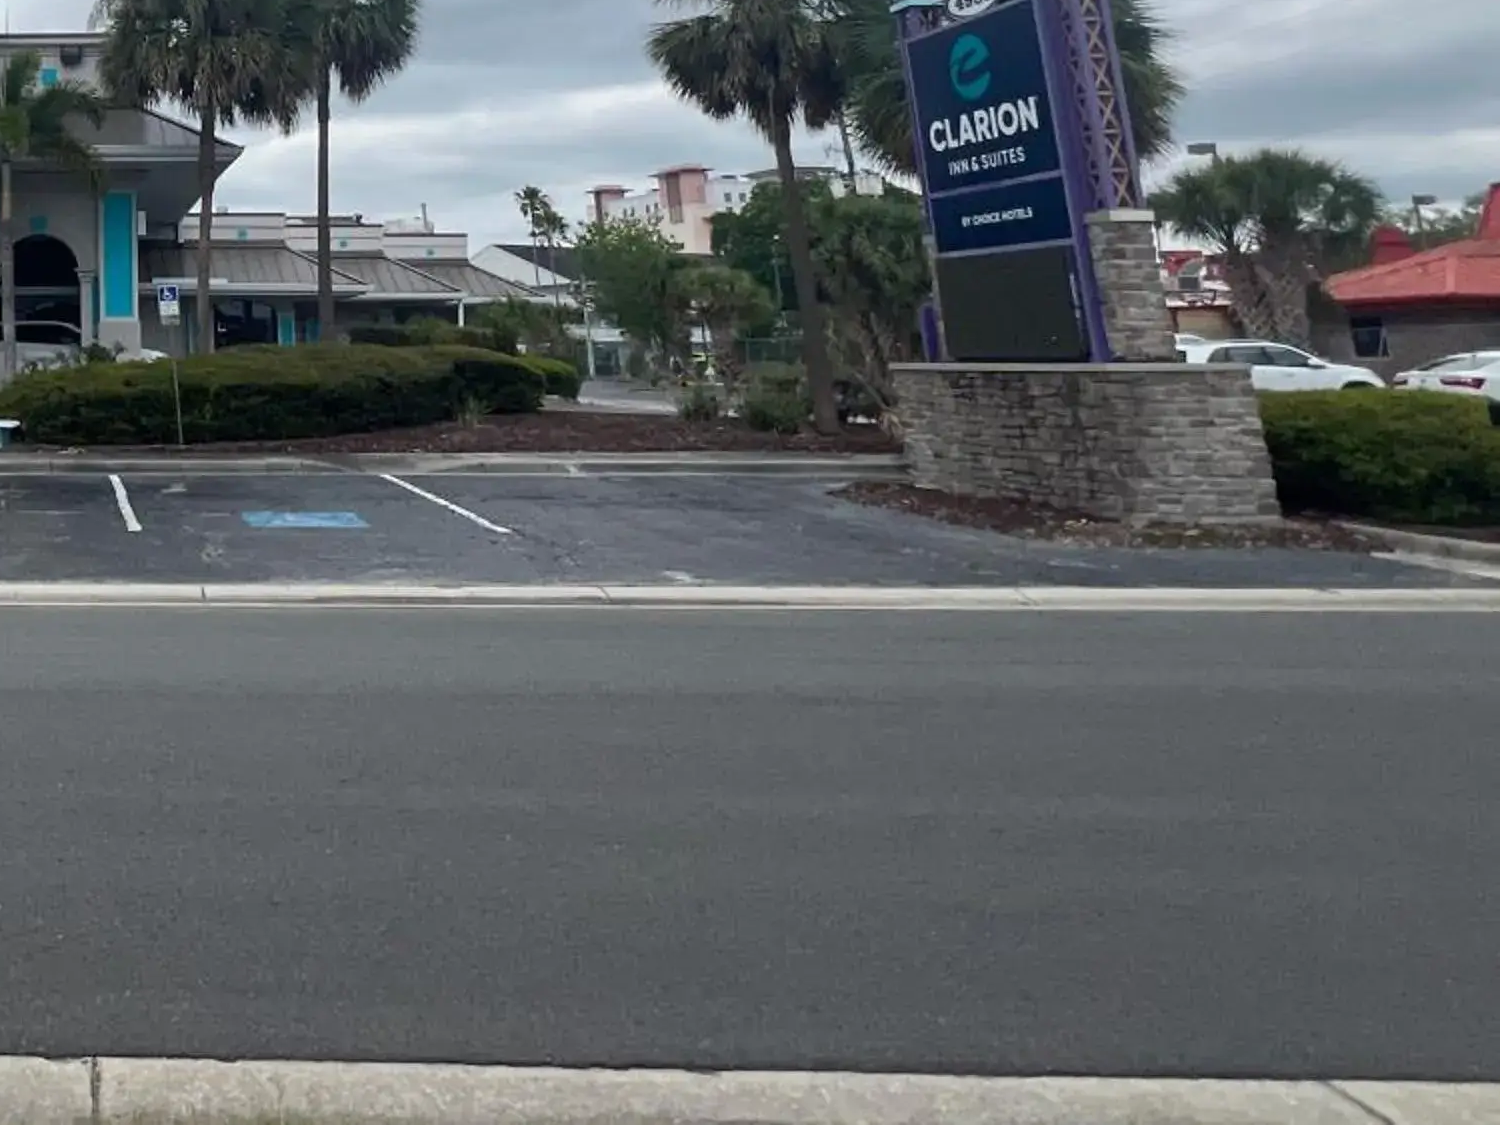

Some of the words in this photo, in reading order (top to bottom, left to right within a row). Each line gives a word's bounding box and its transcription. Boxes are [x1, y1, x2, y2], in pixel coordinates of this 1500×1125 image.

[929, 96, 1039, 152] CLARION
[948, 159, 970, 176] INN
[971, 156, 980, 172] &
[981, 146, 1027, 170] SUITES
